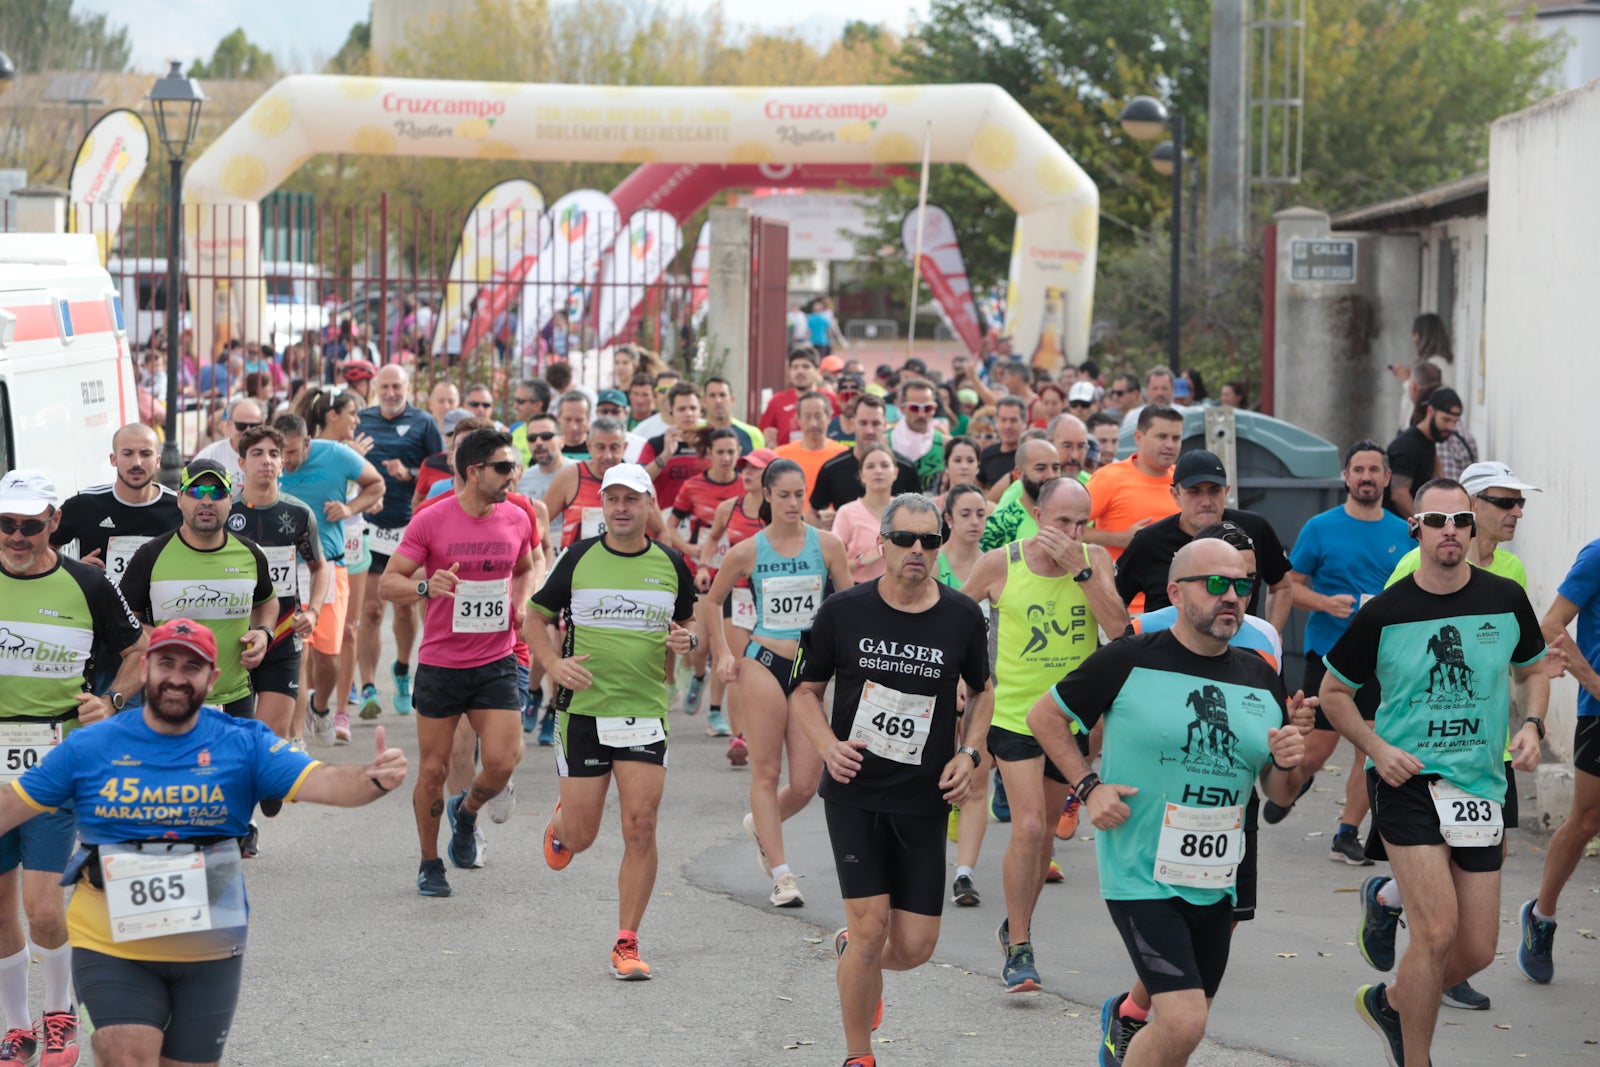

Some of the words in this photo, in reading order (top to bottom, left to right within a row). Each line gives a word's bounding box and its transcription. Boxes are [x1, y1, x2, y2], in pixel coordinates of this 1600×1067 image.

[382, 92, 506, 117] Cruzcampo
[764, 99, 888, 121] Cruzcampo
[1312, 243, 1349, 256] CALLE
[376, 528, 400, 542] 654
[756, 558, 810, 574] nerja
[460, 601, 504, 617] 3136
[770, 595, 815, 614] 3074
[858, 637, 945, 665] GALSER
[858, 657, 941, 679] estanterías
[871, 711, 915, 739] 469
[1427, 718, 1480, 737] HSN
[1211, 768, 1237, 778] Albolote
[99, 777, 140, 803] 45
[141, 784, 225, 804] MEDIA
[1181, 784, 1239, 807] HSN
[94, 804, 182, 820] MARATON
[188, 805, 229, 818] BAZA
[1452, 800, 1492, 822] 283
[1180, 833, 1228, 858] 860
[130, 874, 185, 906] 865
